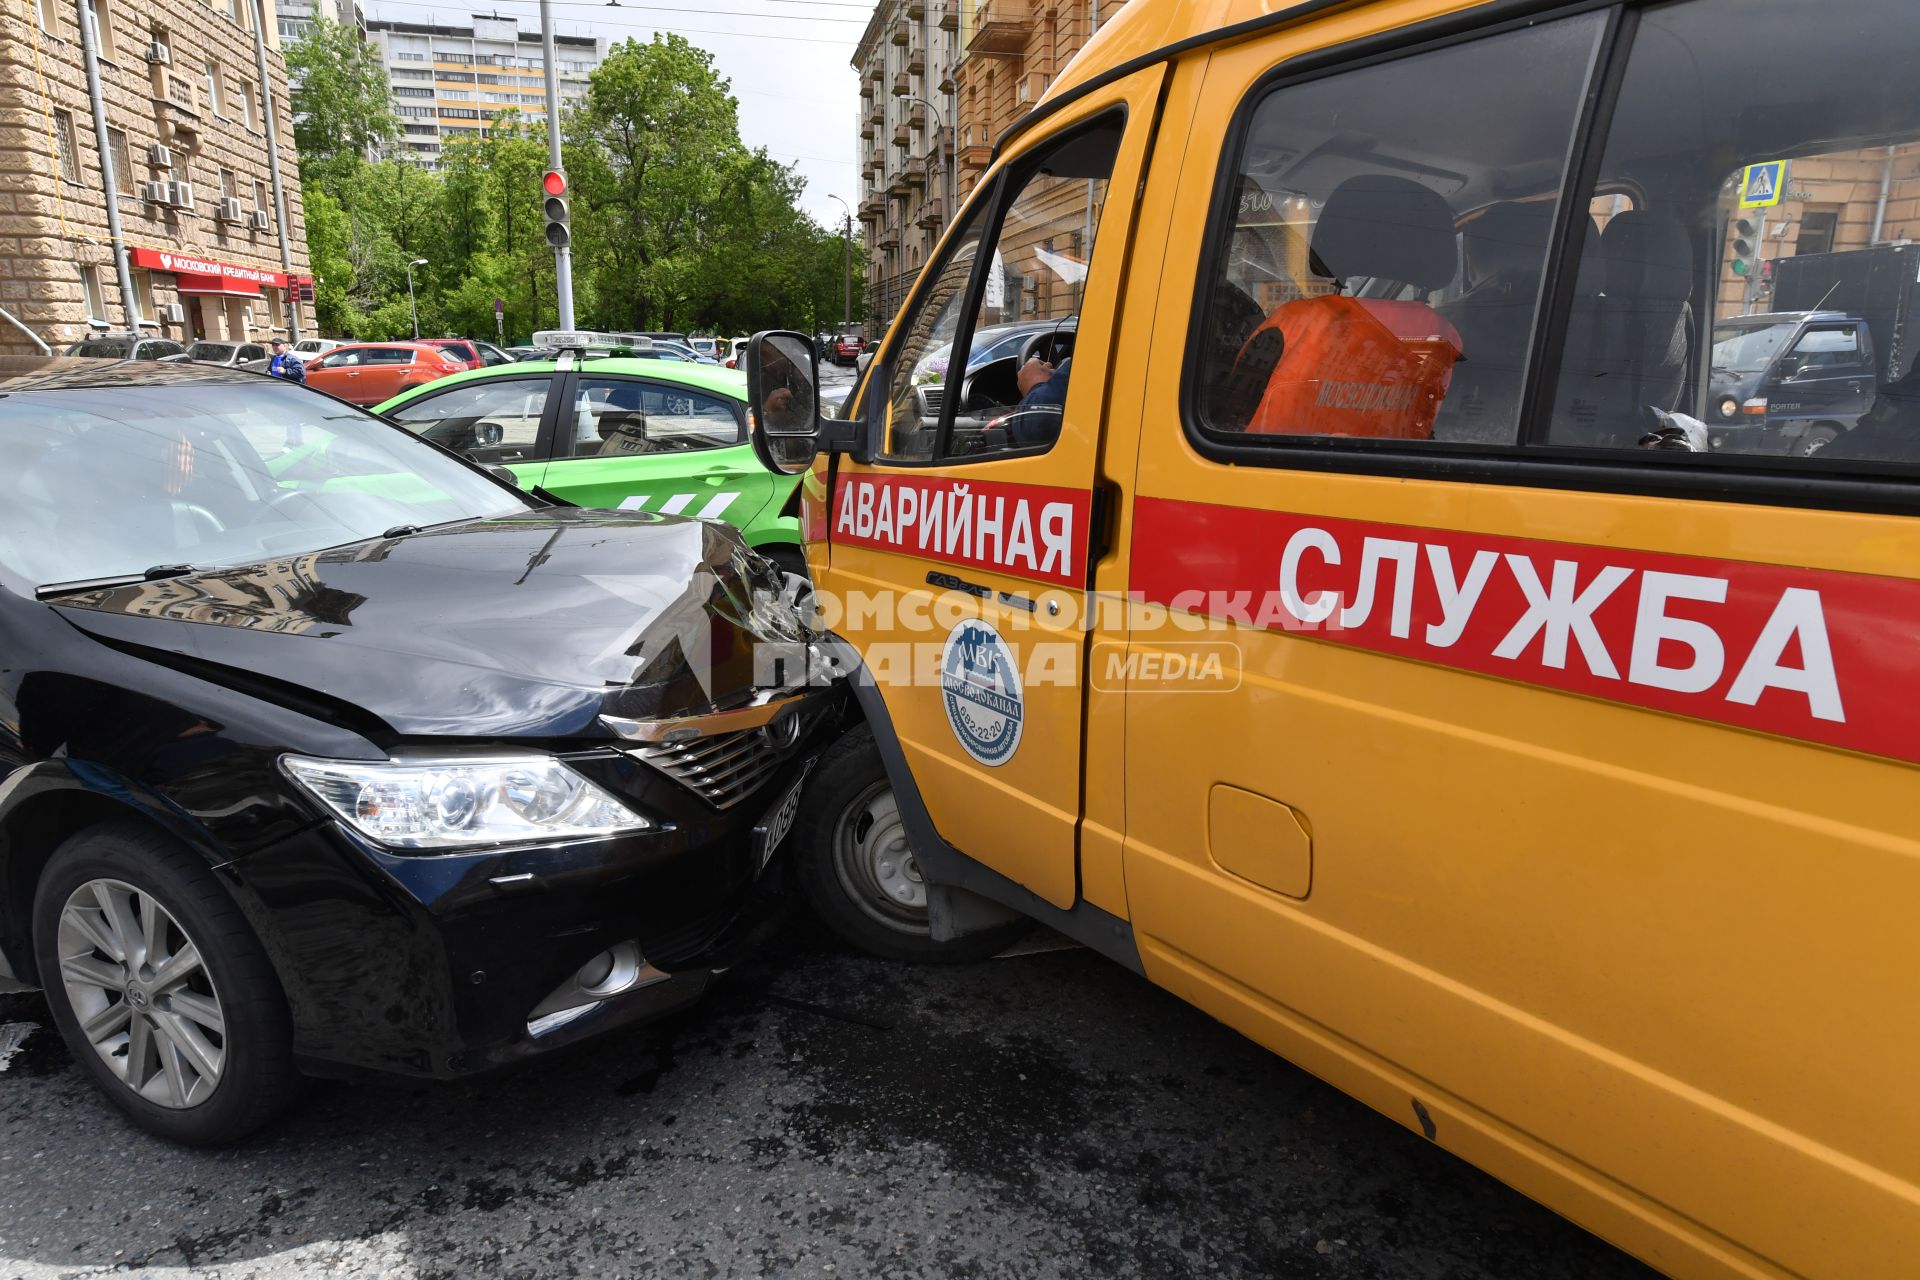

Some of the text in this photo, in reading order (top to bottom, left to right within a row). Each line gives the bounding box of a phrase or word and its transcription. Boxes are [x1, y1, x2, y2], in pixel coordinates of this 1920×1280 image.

[173, 257, 276, 284] МОСКОВСКИЙ КРЕДИТНЫЙ БАНК
[837, 481, 1846, 723] АВАРИЙНАЯ СЛУЖБА
[958, 640, 1003, 673] МВК
[944, 676, 1020, 717] МОСВОДОКАНАЛ
